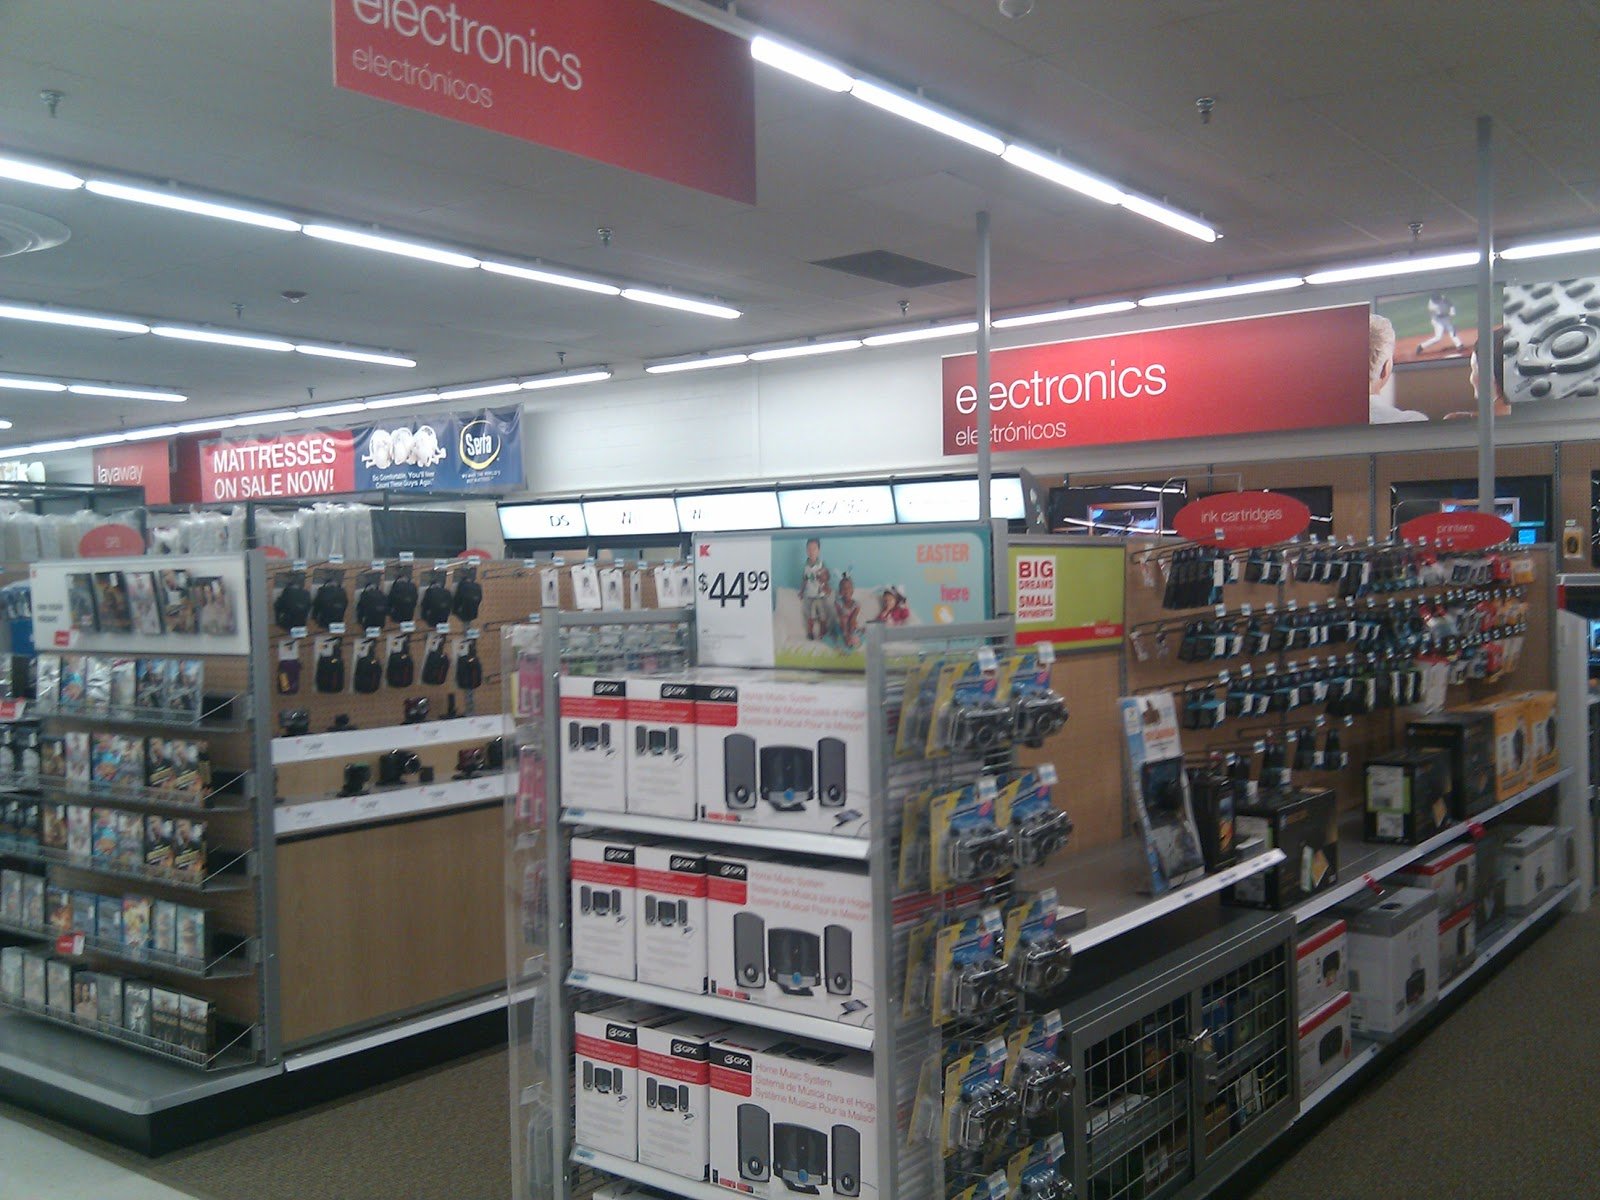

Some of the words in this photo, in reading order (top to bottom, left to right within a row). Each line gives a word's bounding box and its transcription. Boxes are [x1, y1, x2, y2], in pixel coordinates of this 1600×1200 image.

[352, 46, 493, 108] electrónicos
[956, 359, 1167, 414] eectronics
[465, 432, 492, 457] Serta
[955, 421, 1067, 446] eletrónicos
[213, 438, 337, 474] MATTRESSES
[97, 464, 143, 484] layaway
[214, 478, 237, 499] ON
[241, 474, 283, 498] SALE
[287, 472, 335, 495] NOW!
[1201, 510, 1218, 523] ink
[1221, 508, 1283, 523] cartridges
[916, 543, 970, 564] EASTER
[1019, 561, 1054, 578] BIG
[1019, 596, 1054, 608] SMALL
